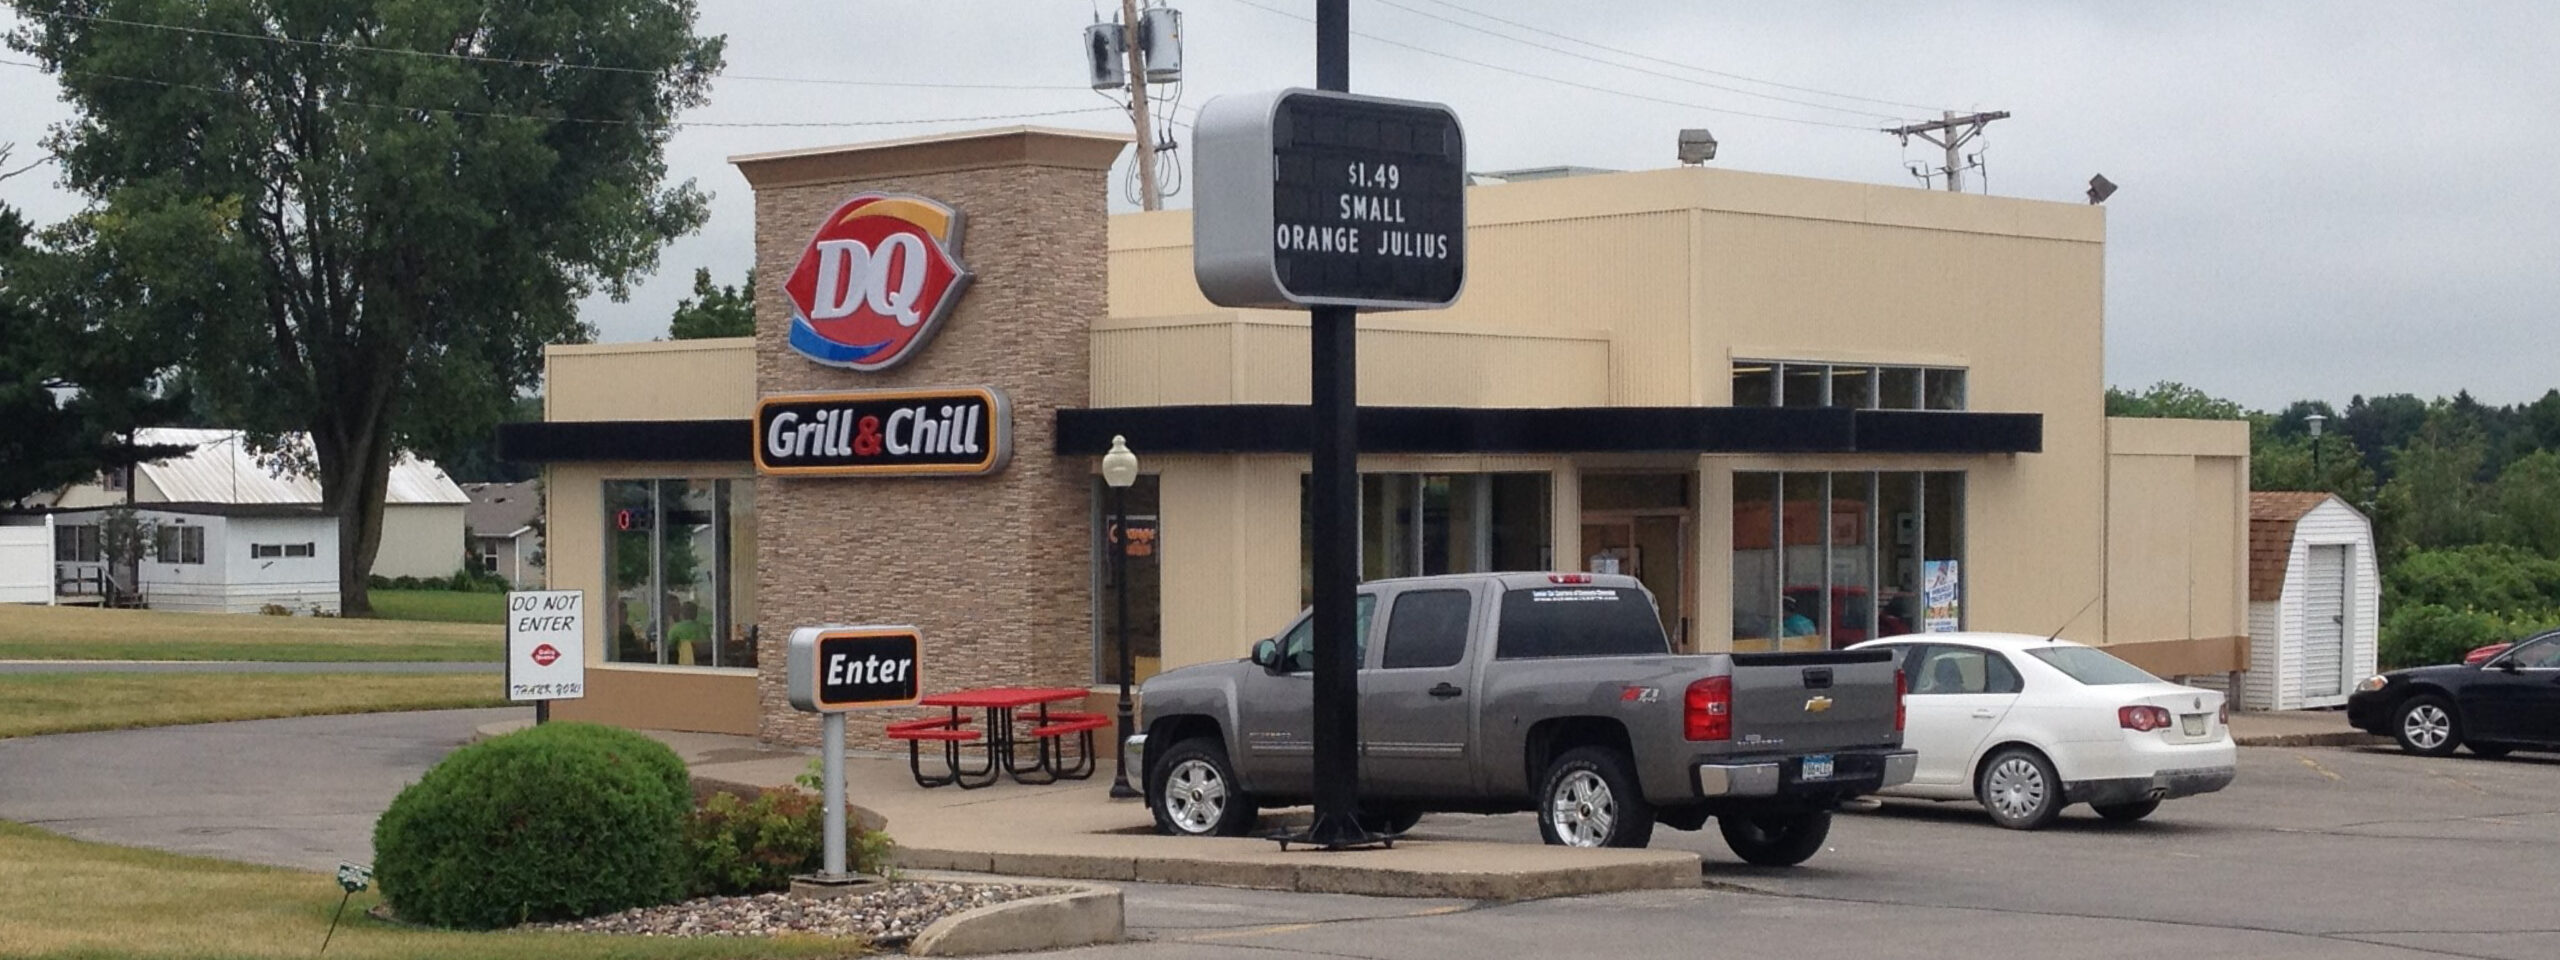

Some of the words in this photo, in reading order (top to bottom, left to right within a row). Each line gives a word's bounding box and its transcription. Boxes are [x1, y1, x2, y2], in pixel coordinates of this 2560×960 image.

[1349, 161, 1400, 190] $1.49
[1340, 193, 1405, 223] SMALL
[1277, 223, 1359, 253] ORANGE
[1377, 230, 1448, 260] JULIUS
[810, 232, 929, 328] DQ
[511, 595, 538, 612] DO
[543, 595, 580, 611] NOT
[518, 616, 575, 632] ENTER
[827, 653, 912, 686] Enter
